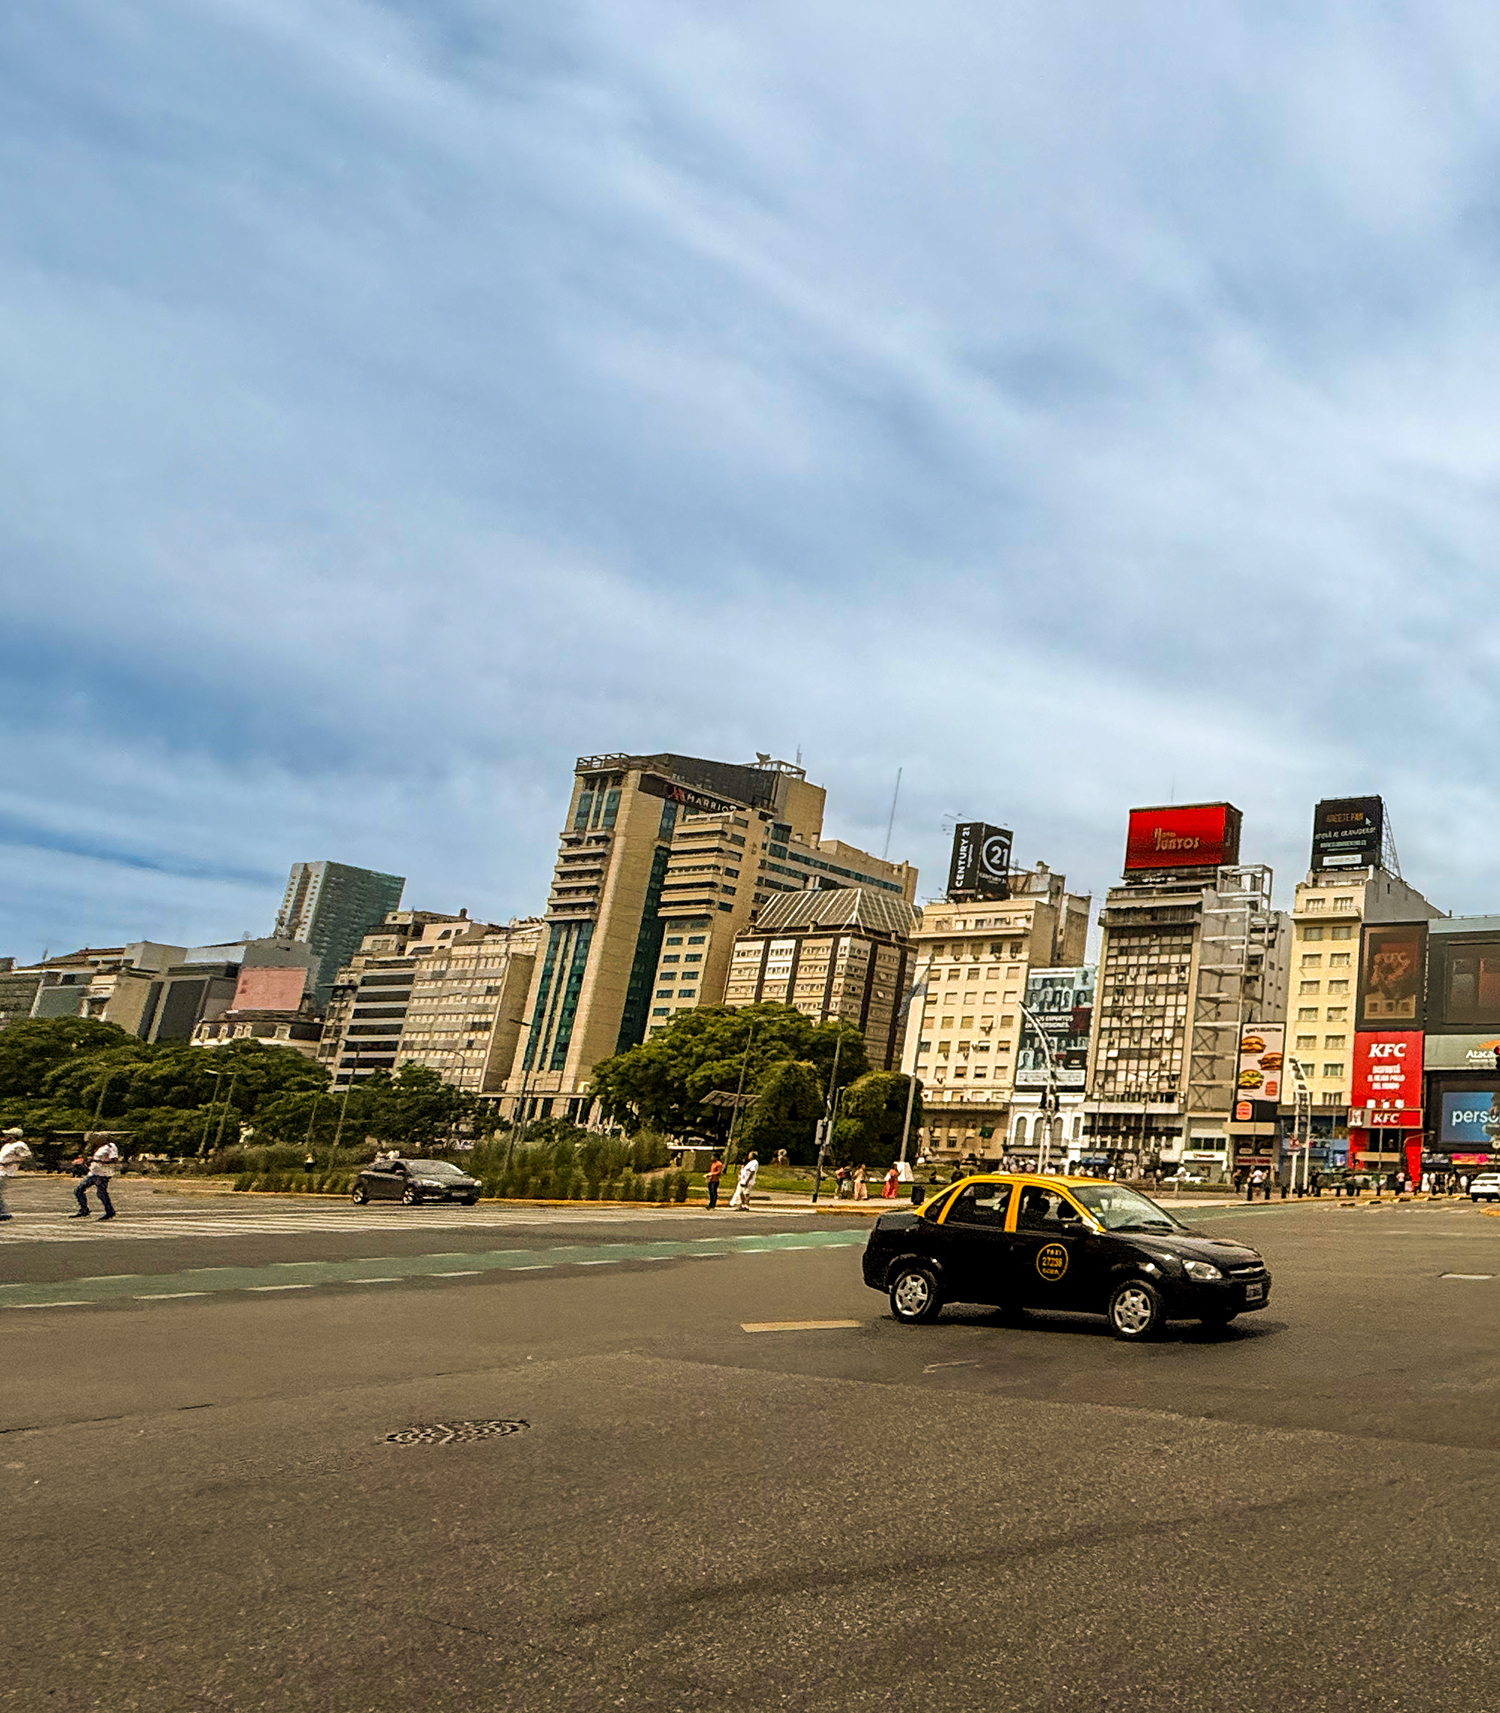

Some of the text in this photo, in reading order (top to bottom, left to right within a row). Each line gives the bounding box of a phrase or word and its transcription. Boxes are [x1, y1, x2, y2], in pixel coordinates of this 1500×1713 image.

[955, 826, 972, 888] CENTURY 21
[990, 845, 1009, 867] 21
[1368, 1043, 1407, 1058] KFC
[1373, 1113, 1400, 1123] KFC
